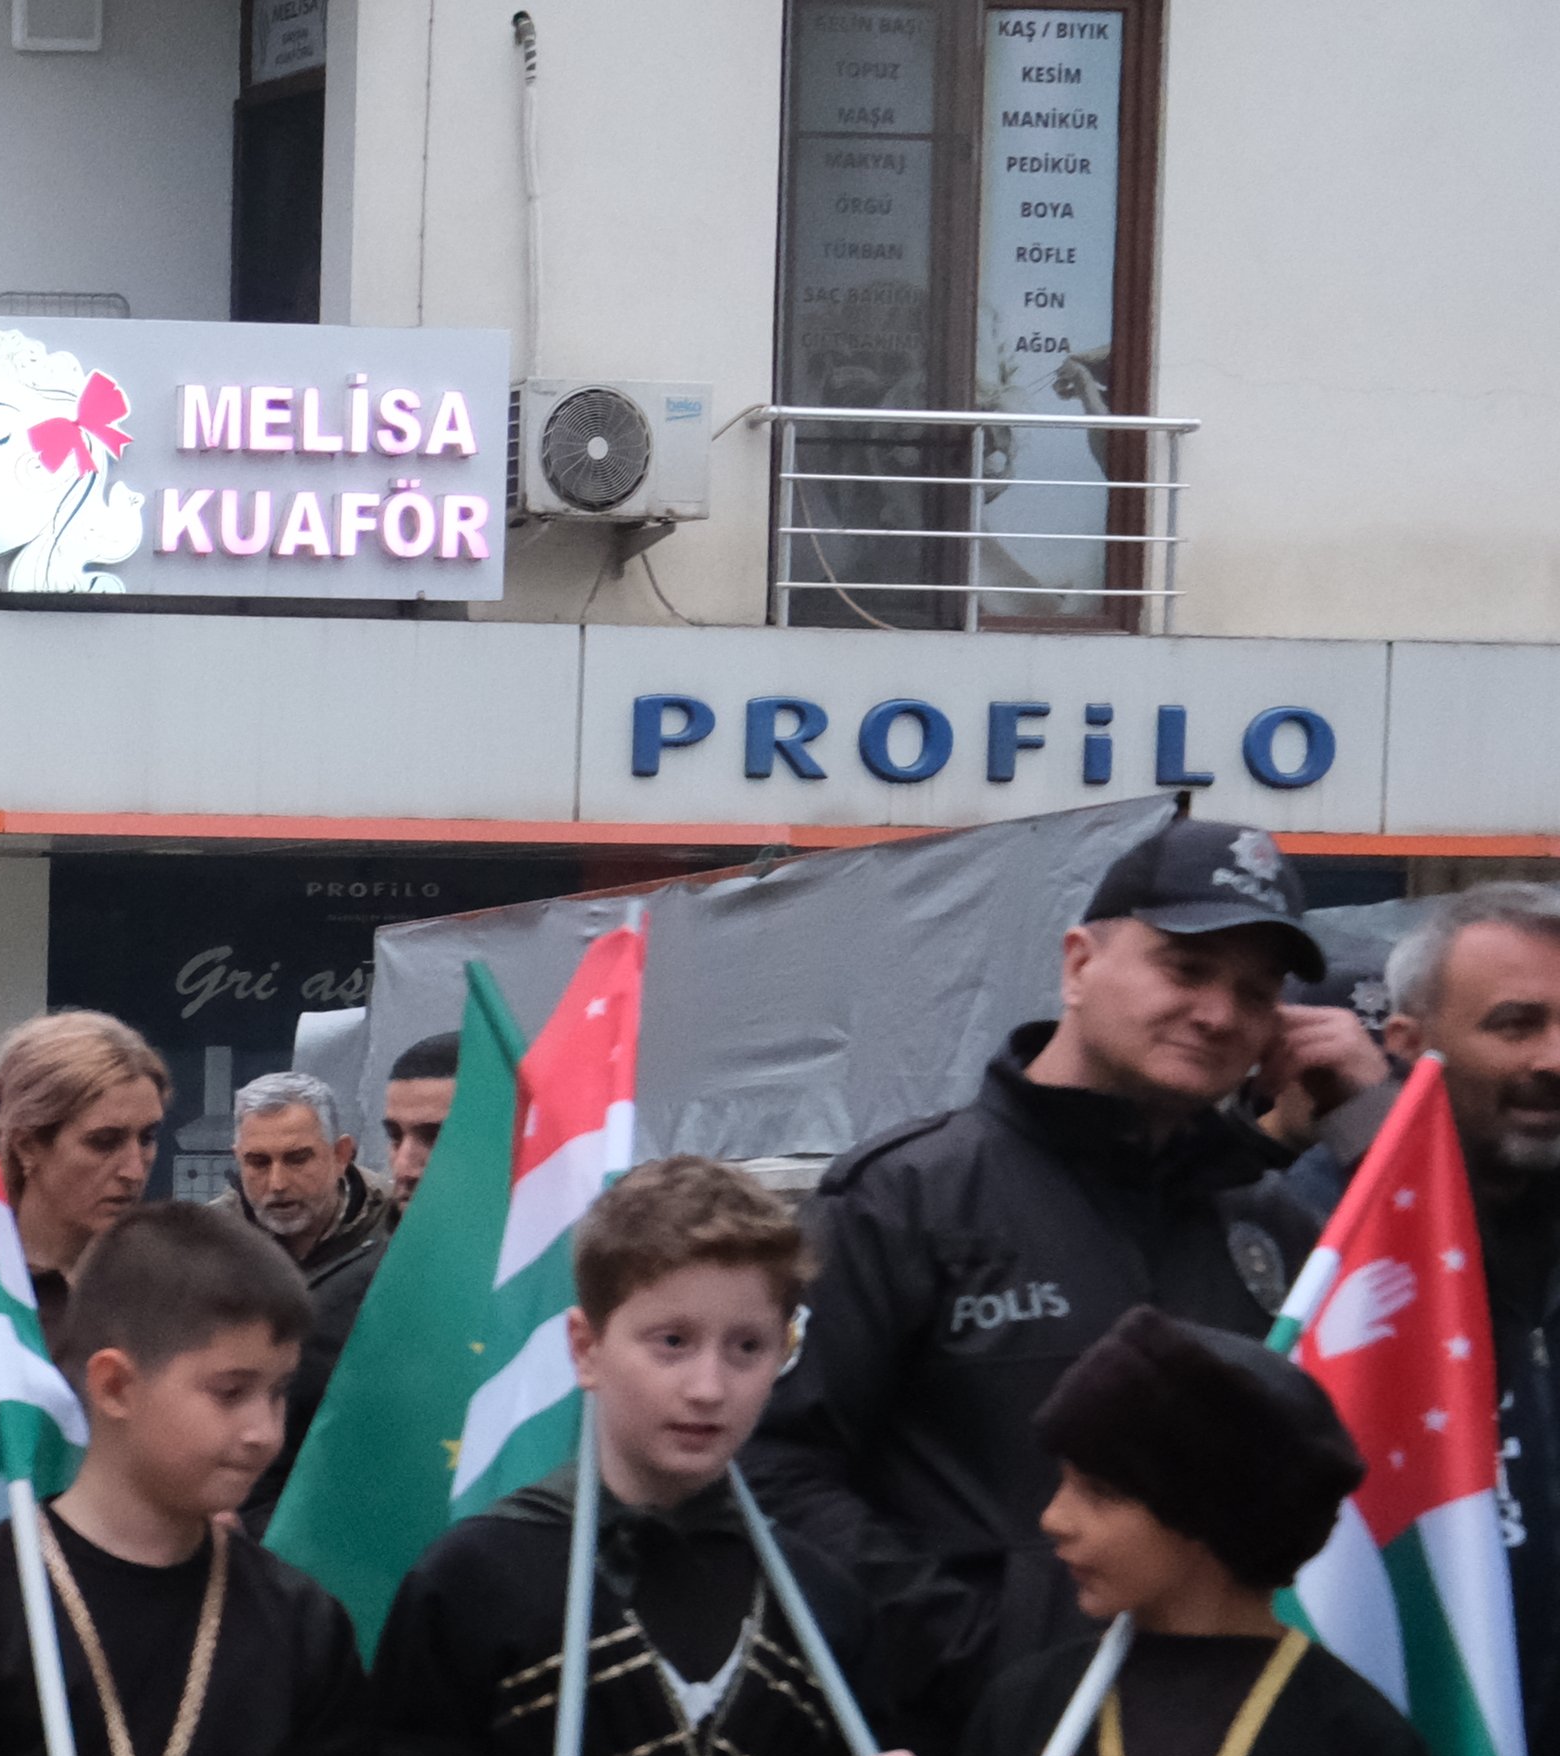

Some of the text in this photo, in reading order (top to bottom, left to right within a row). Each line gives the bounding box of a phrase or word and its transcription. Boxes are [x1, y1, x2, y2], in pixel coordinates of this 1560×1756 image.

[998, 20, 1036, 42] KAŞ
[1056, 22, 1109, 40] BIYIK
[835, 61, 901, 80] TOPUZ
[1022, 63, 1082, 84] KESİM
[837, 107, 896, 129] MAŞA
[1002, 108, 1098, 130] MANİKÜR
[824, 152, 906, 175] MAKYAJ
[1006, 152, 1092, 175] PEDİKÜR
[835, 192, 893, 215] ÖRGÜ
[1021, 201, 1074, 219] BOYA
[823, 238, 903, 261] TÜRBAN
[1016, 242, 1077, 264] RÖFLE
[1024, 287, 1066, 309] FÖN
[1015, 332, 1071, 353] AĞDA
[176, 372, 477, 456] MELİSA
[158, 477, 490, 559] KUAFÖR
[175, 945, 280, 1019] Gri
